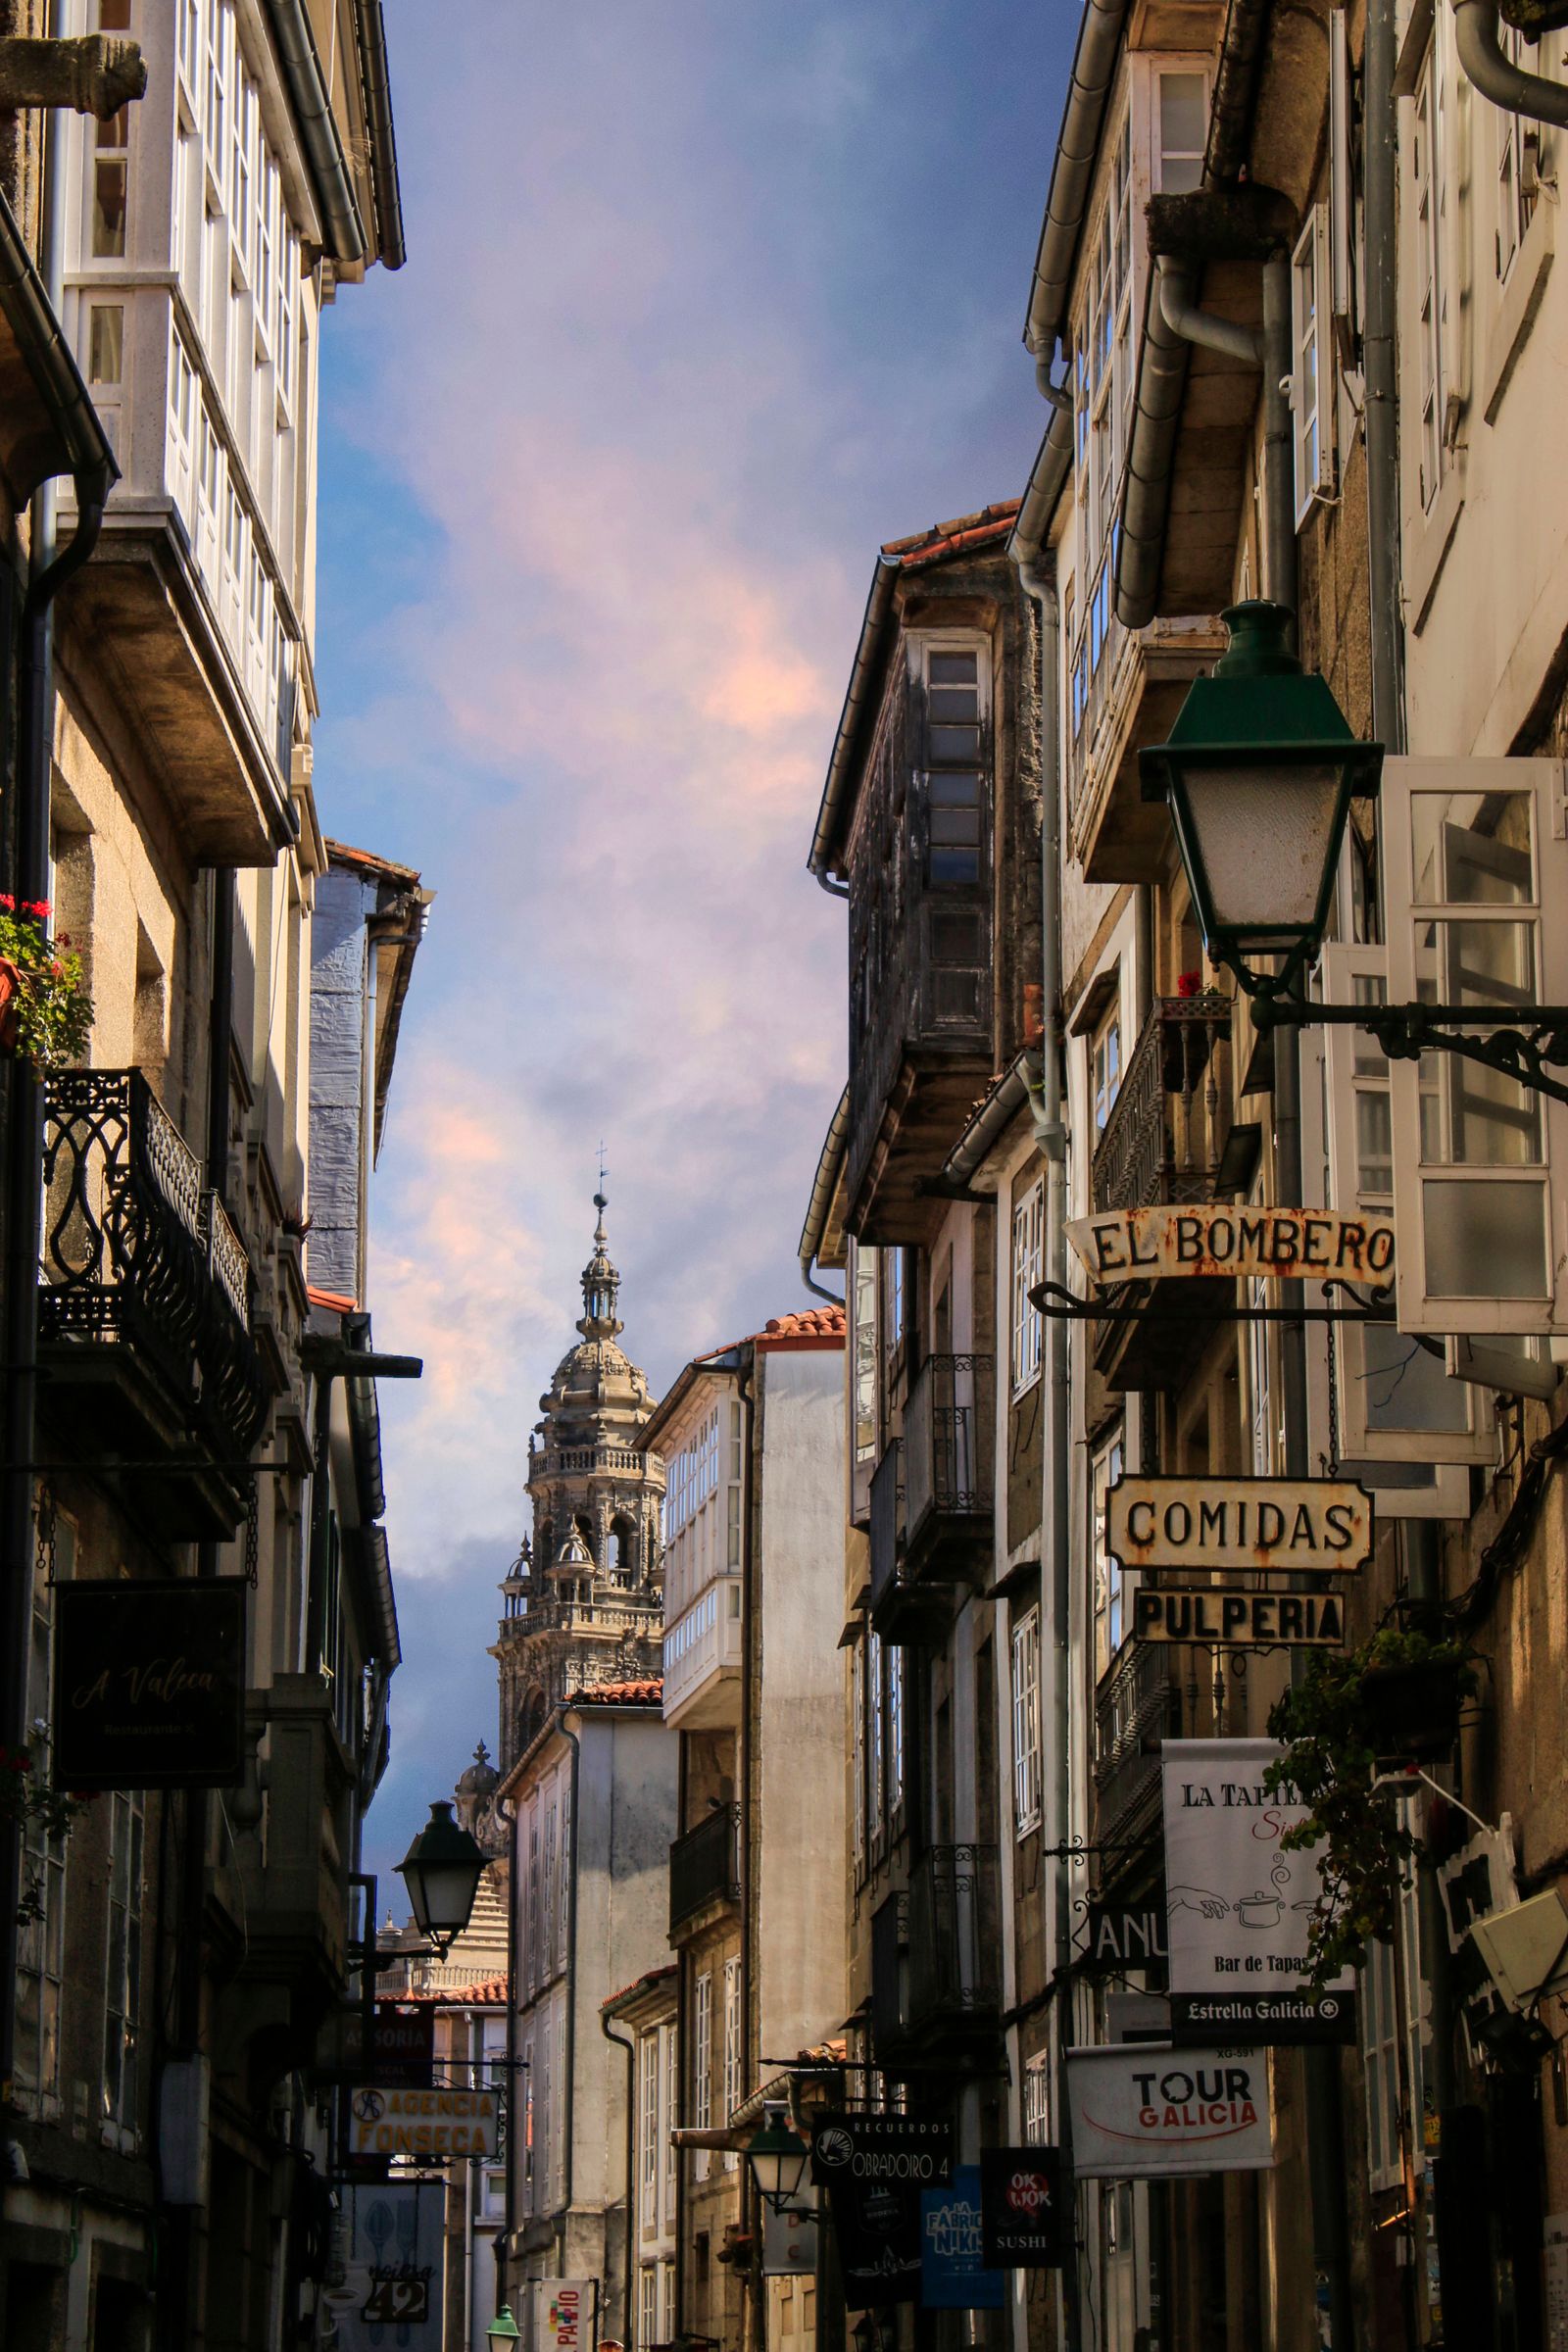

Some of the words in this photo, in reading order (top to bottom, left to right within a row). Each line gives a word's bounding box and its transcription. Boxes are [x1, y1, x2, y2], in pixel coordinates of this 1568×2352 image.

[1092, 1221, 1158, 1271] EL
[1176, 1215, 1395, 1272] BOMBERO
[1127, 1500, 1354, 1550] COMIDAS
[1137, 1595, 1342, 1640] PULPERIA
[102, 1724, 181, 1736] Restaurante
[1214, 1956, 1240, 1973] Bar
[1245, 1955, 1262, 1972] de
[1188, 2002, 1251, 2020] Estrella
[1255, 2000, 1315, 2020] Galicia
[1133, 2069, 1251, 2106] TOUR
[389, 2092, 494, 2118] AGENCIA
[1139, 2101, 1257, 2129] GALICIA
[358, 2123, 487, 2154] FONSECA
[854, 2123, 950, 2134] RECUERDOS
[852, 2151, 933, 2179] OBRADOIRO
[939, 2157, 949, 2179] 4
[1010, 2173, 1036, 2190] OK
[1010, 2190, 1053, 2207] WOK
[928, 2206, 981, 2228] FÁBRIC
[996, 2235, 1048, 2249] SUSHI
